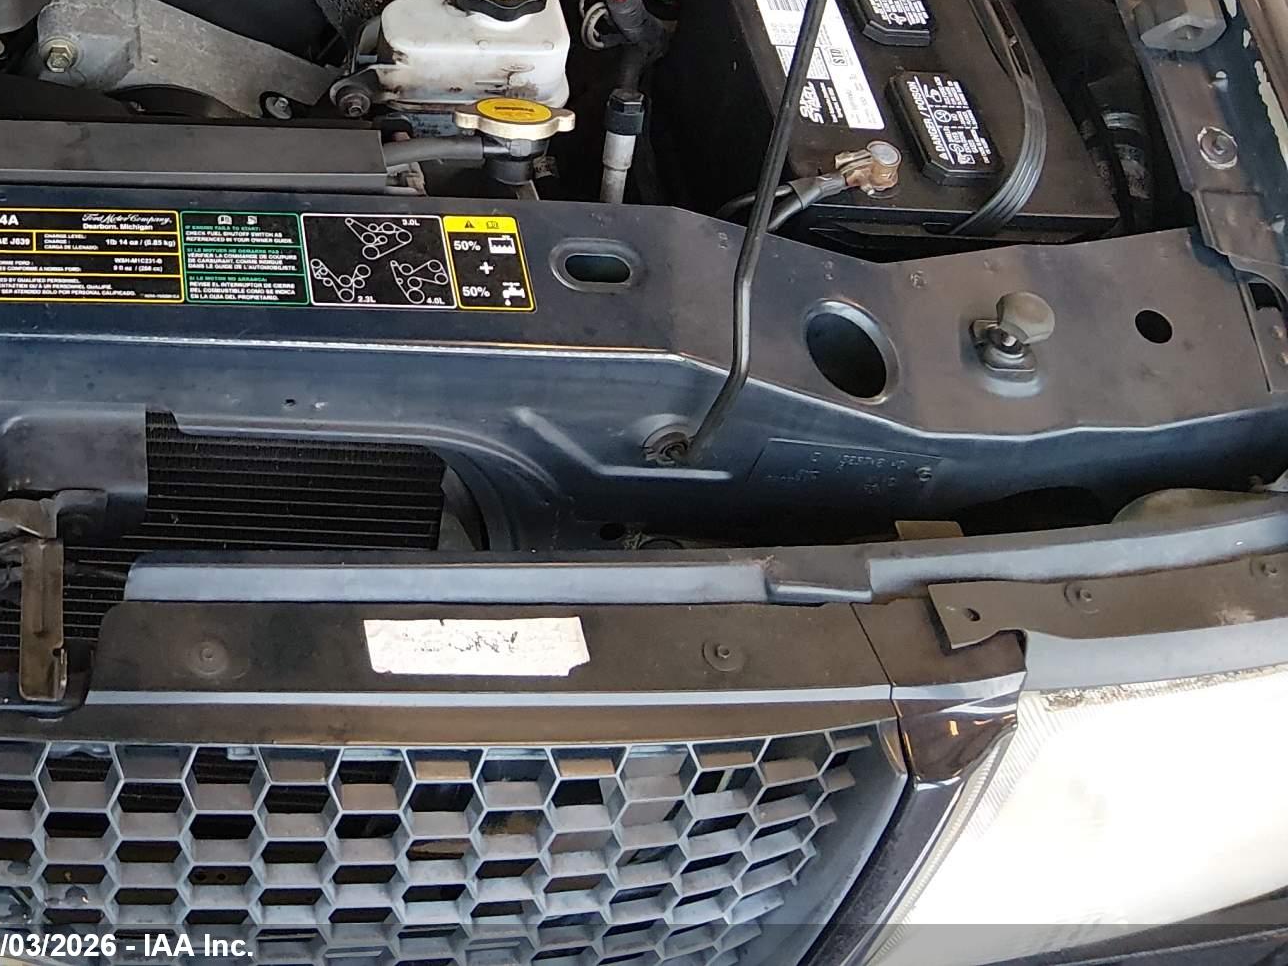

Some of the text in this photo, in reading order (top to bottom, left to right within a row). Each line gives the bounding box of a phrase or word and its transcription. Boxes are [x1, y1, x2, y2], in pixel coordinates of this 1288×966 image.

[906, 81, 945, 151] DANGER POISON
[82, 214, 102, 222] Ford
[102, 214, 127, 223] Motor
[454, 240, 481, 251] 50%
[462, 287, 490, 297] 50%
